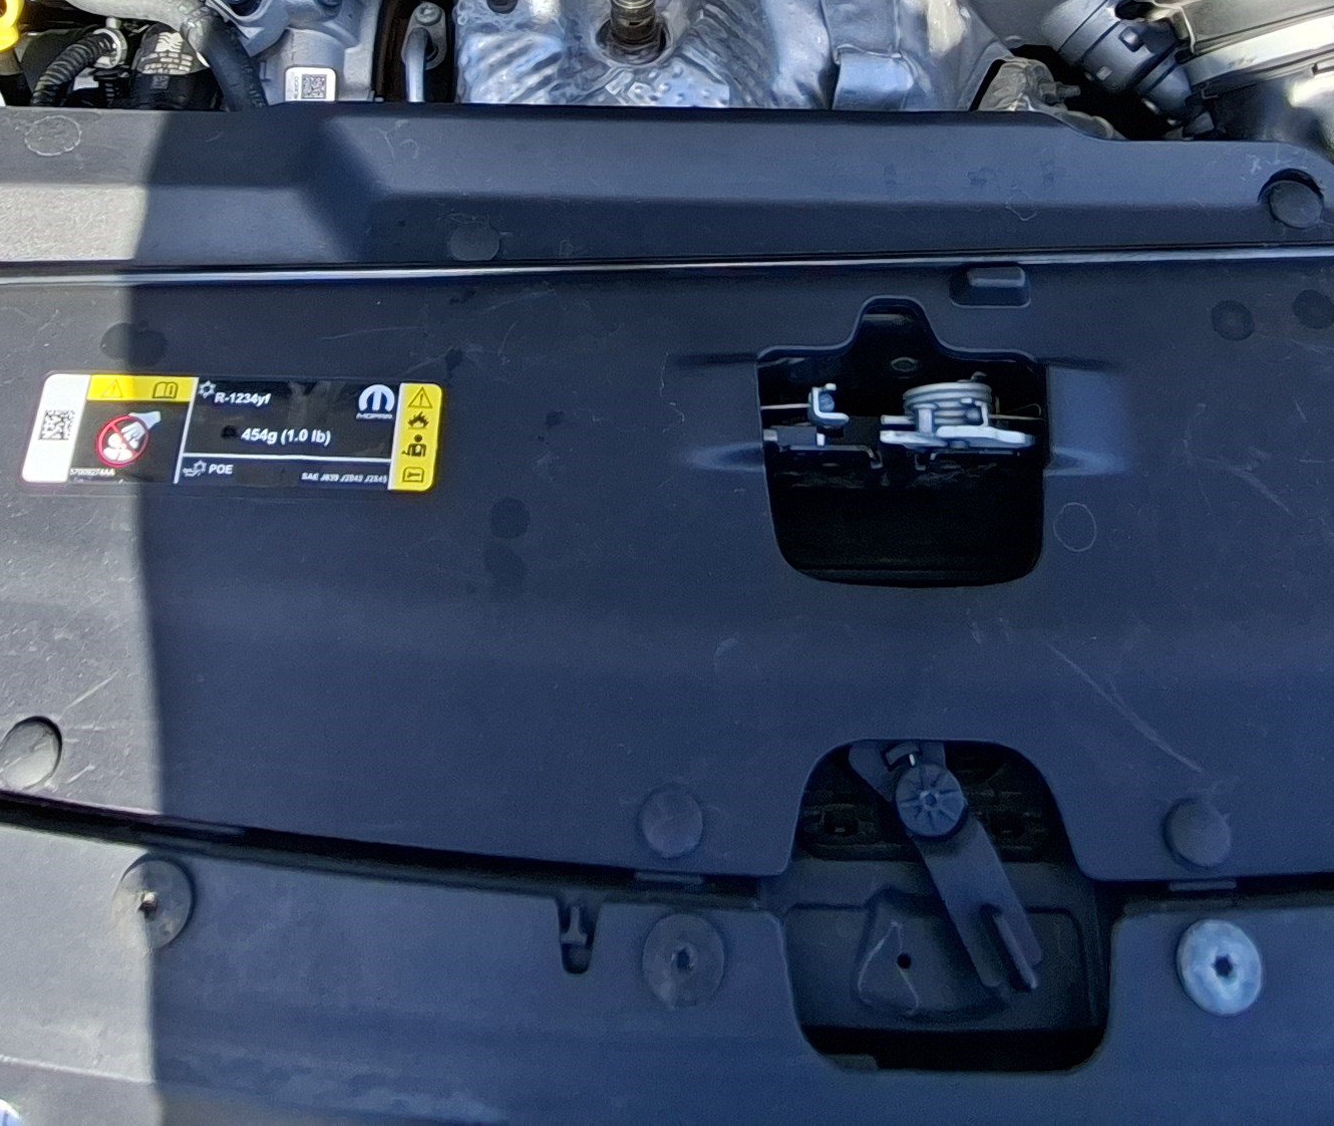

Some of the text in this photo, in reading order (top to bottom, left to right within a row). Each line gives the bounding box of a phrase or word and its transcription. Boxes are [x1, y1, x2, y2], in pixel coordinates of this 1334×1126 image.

[214, 392, 272, 407] R-1234yf
[241, 428, 332, 446] 454g (1.0 lb)
[208, 463, 234, 475] POE
